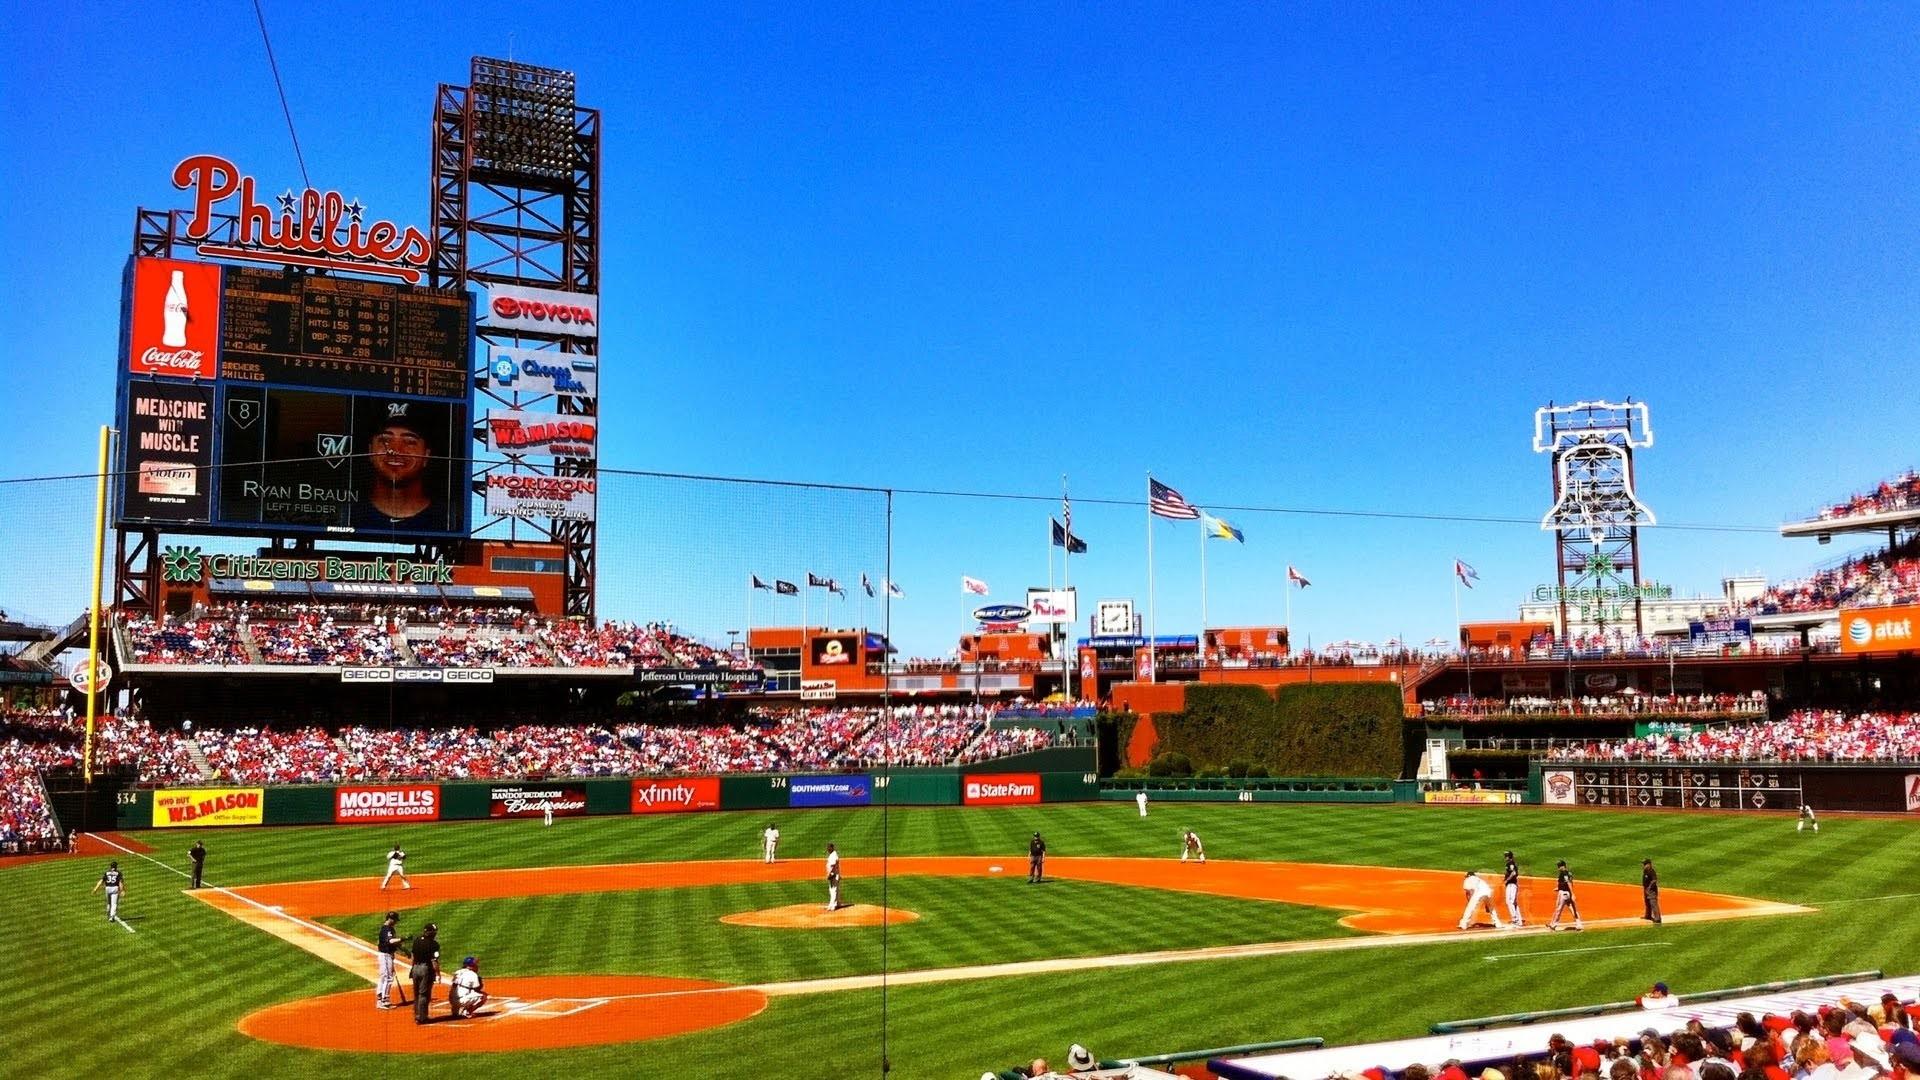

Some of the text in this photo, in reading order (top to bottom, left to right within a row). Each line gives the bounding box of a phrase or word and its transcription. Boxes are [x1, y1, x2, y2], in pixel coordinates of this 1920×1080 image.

[172, 154, 433, 266] Phillies
[241, 268, 284, 279] BREWERS
[413, 287, 457, 298] PHILLIES
[519, 301, 595, 326] TOYOTA
[222, 361, 260, 372] BREWERS
[295, 359, 301, 367] 2
[333, 362, 339, 370] 5
[222, 370, 265, 381] PHILLIES
[136, 398, 206, 419] MEDICINE
[239, 403, 250, 419] 8
[141, 432, 199, 453] MUSCLE
[487, 475, 595, 494] HORIZON
[243, 480, 359, 503] RYAN BRAUN
[266, 503, 336, 513] LEFT FIELDER
[517, 500, 565, 510] PLUMBING
[492, 506, 588, 520] HEATING COOLING
[209, 553, 453, 583] Citizens Bank Park
[1536, 580, 1672, 601] Citizens Bank
[1580, 604, 1622, 622] Park
[1875, 618, 1912, 640] at&t
[343, 670, 492, 680] GEICO GEICO GEICO
[641, 671, 758, 682] Jefferson University Hospitals
[771, 777, 786, 788] 374
[1083, 774, 1096, 784] 409
[639, 784, 695, 806] xfinity
[981, 783, 1035, 797] State Farm
[1238, 791, 1253, 802] 401
[117, 792, 136, 805] 334
[340, 789, 434, 808] MODELL'S
[1506, 793, 1522, 804] 398
[340, 806, 434, 818] SPORTING GOODS
